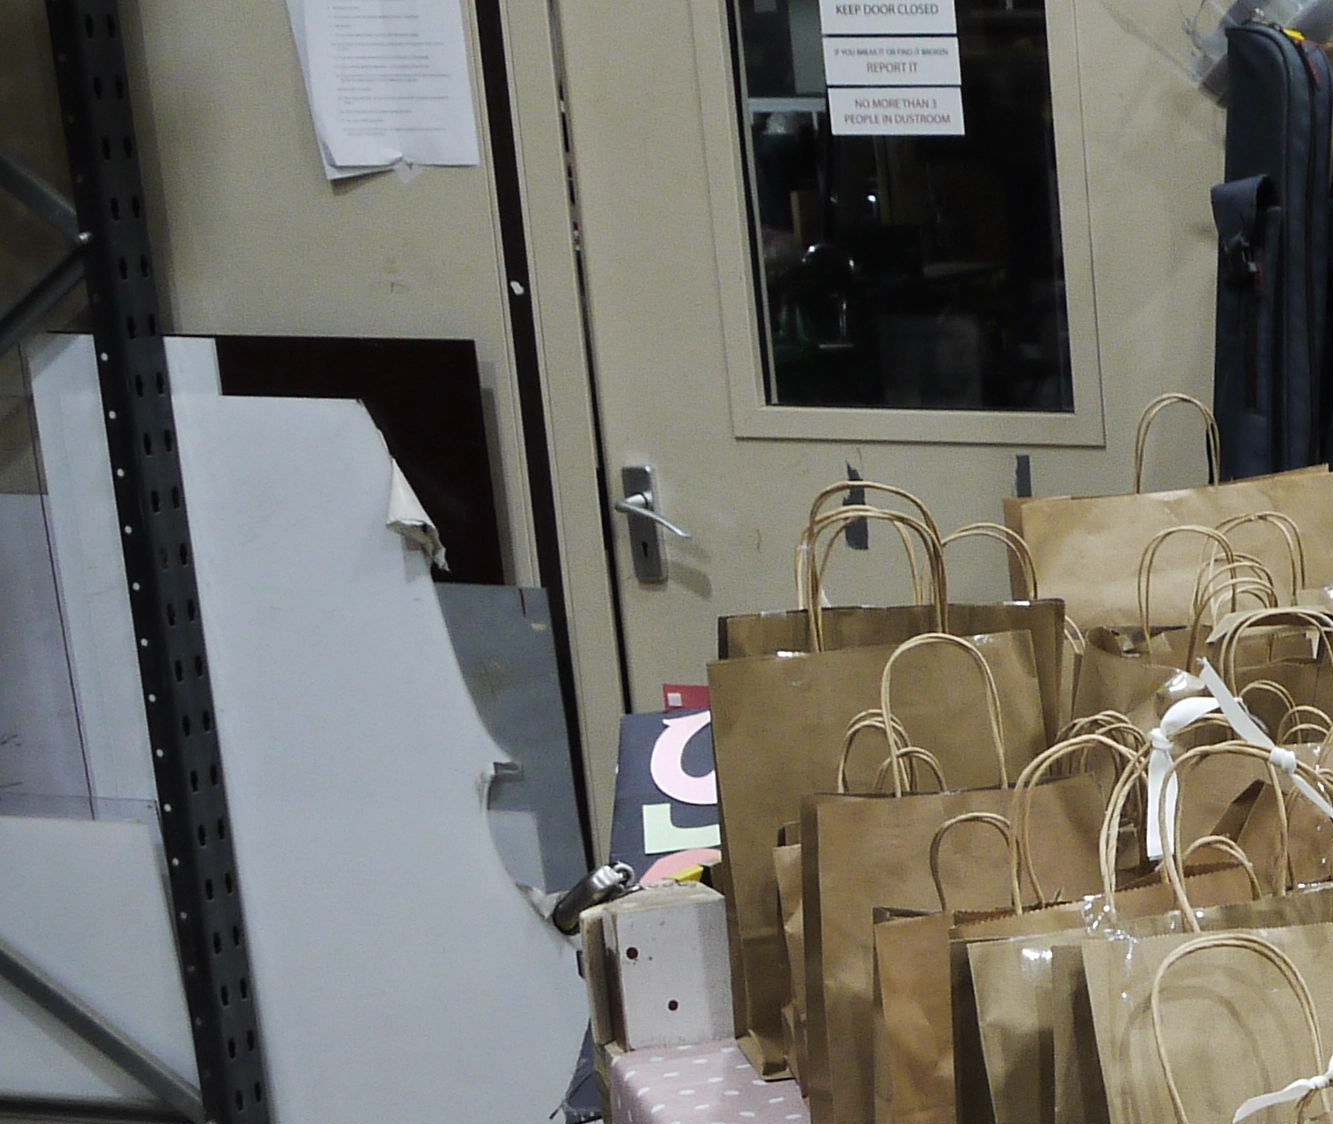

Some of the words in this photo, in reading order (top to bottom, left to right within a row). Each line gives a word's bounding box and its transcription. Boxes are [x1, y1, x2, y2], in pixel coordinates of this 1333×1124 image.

[835, 4, 861, 15] KEEP
[863, 4, 895, 15] DOOR
[897, 4, 939, 15] CLOSED
[866, 62, 906, 73] REPORT
[909, 62, 918, 73] IT
[855, 99, 870, 108] NO
[872, 98, 900, 108] MORE
[902, 99, 929, 108] THAN
[931, 99, 937, 108] 3
[844, 114, 879, 124] PEOPLE
[882, 114, 893, 124] IN
[894, 114, 951, 124] DUSTROOM
